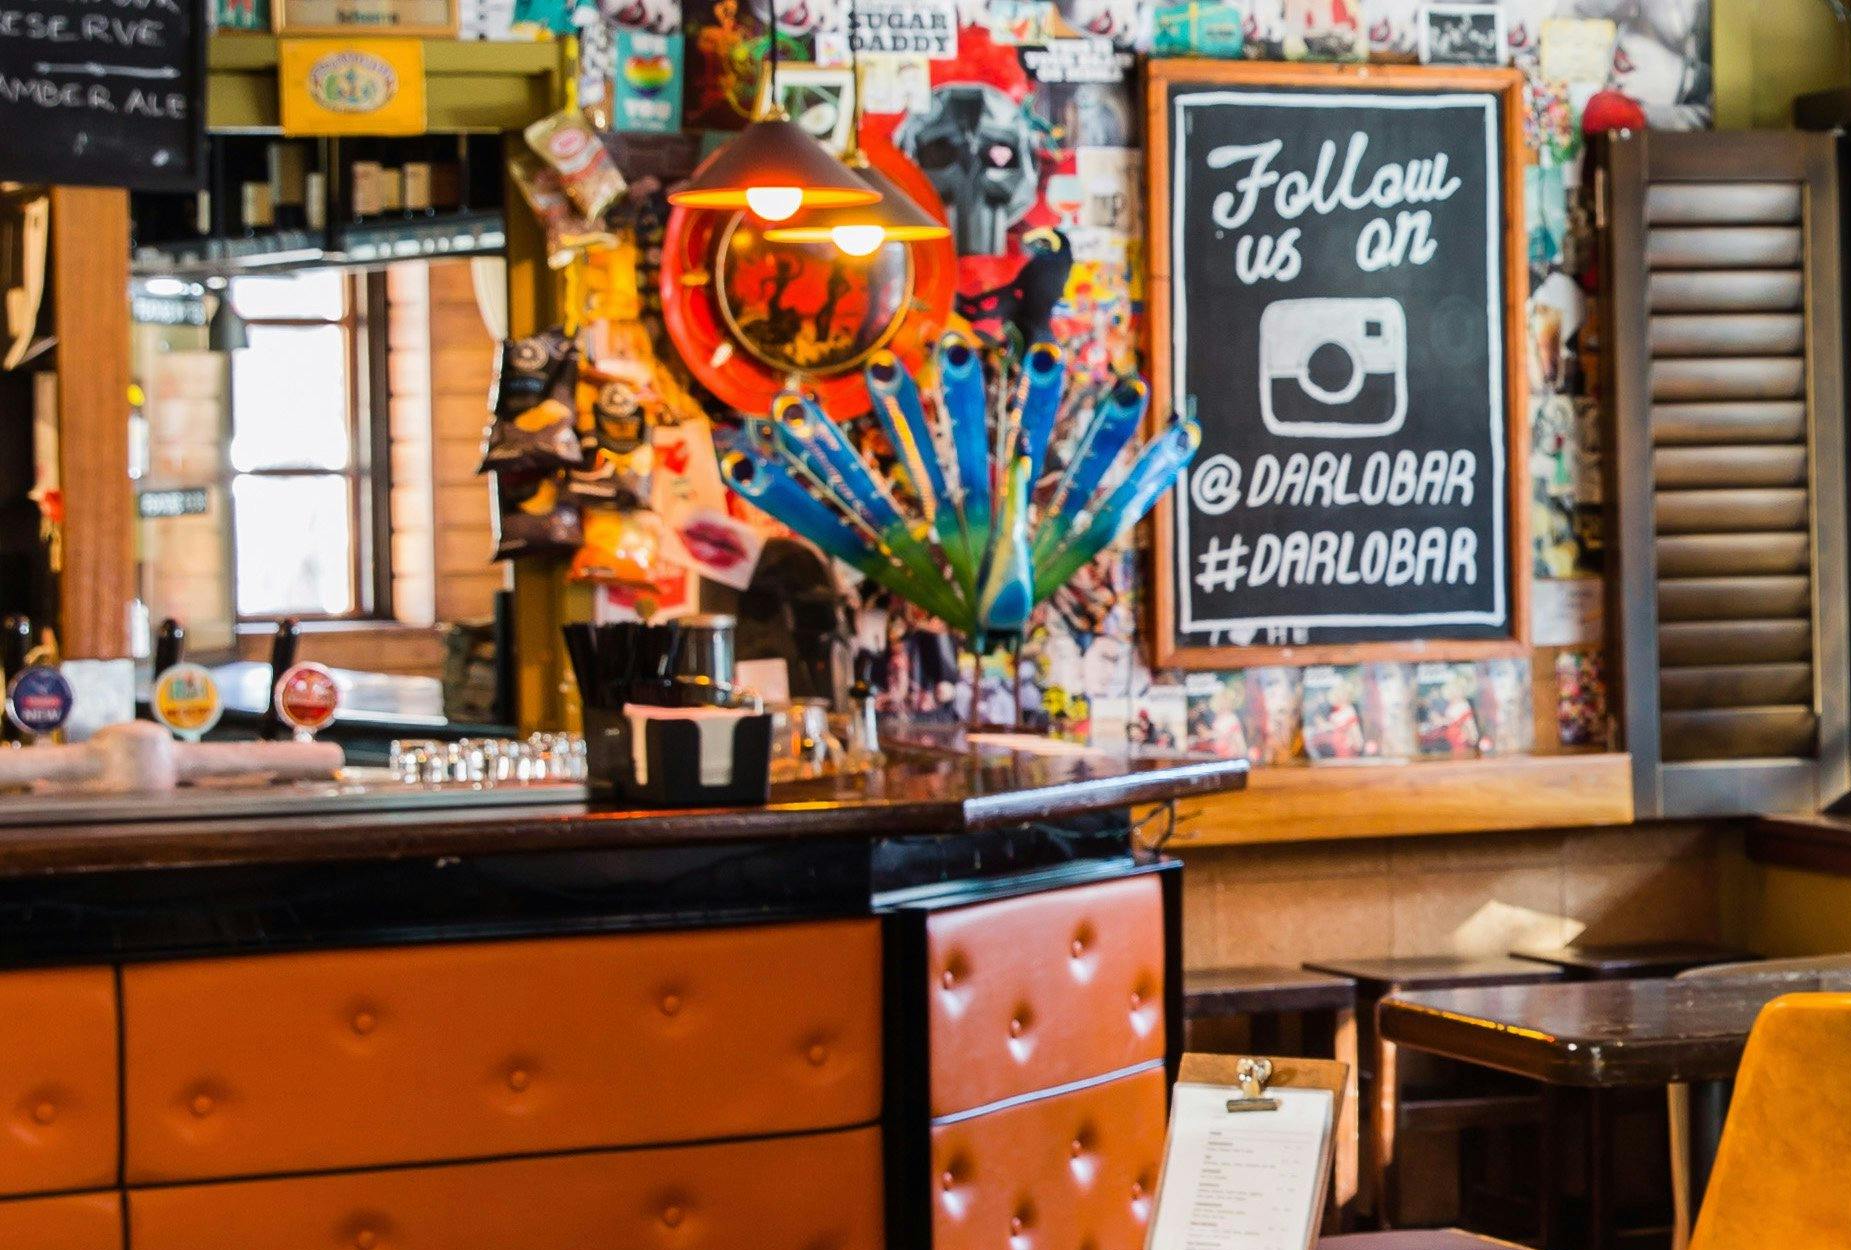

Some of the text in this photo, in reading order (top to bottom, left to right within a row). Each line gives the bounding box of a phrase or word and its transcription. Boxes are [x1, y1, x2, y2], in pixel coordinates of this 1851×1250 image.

[0, 10, 166, 47] ESERVE
[848, 34, 948, 52] DADDY
[124, 88, 187, 120] ALE
[1206, 131, 1462, 229] Follow
[1236, 210, 1438, 285] us on
[1191, 449, 1477, 515] @DARLOBAR
[1195, 527, 1477, 593] #DARLOBAR
